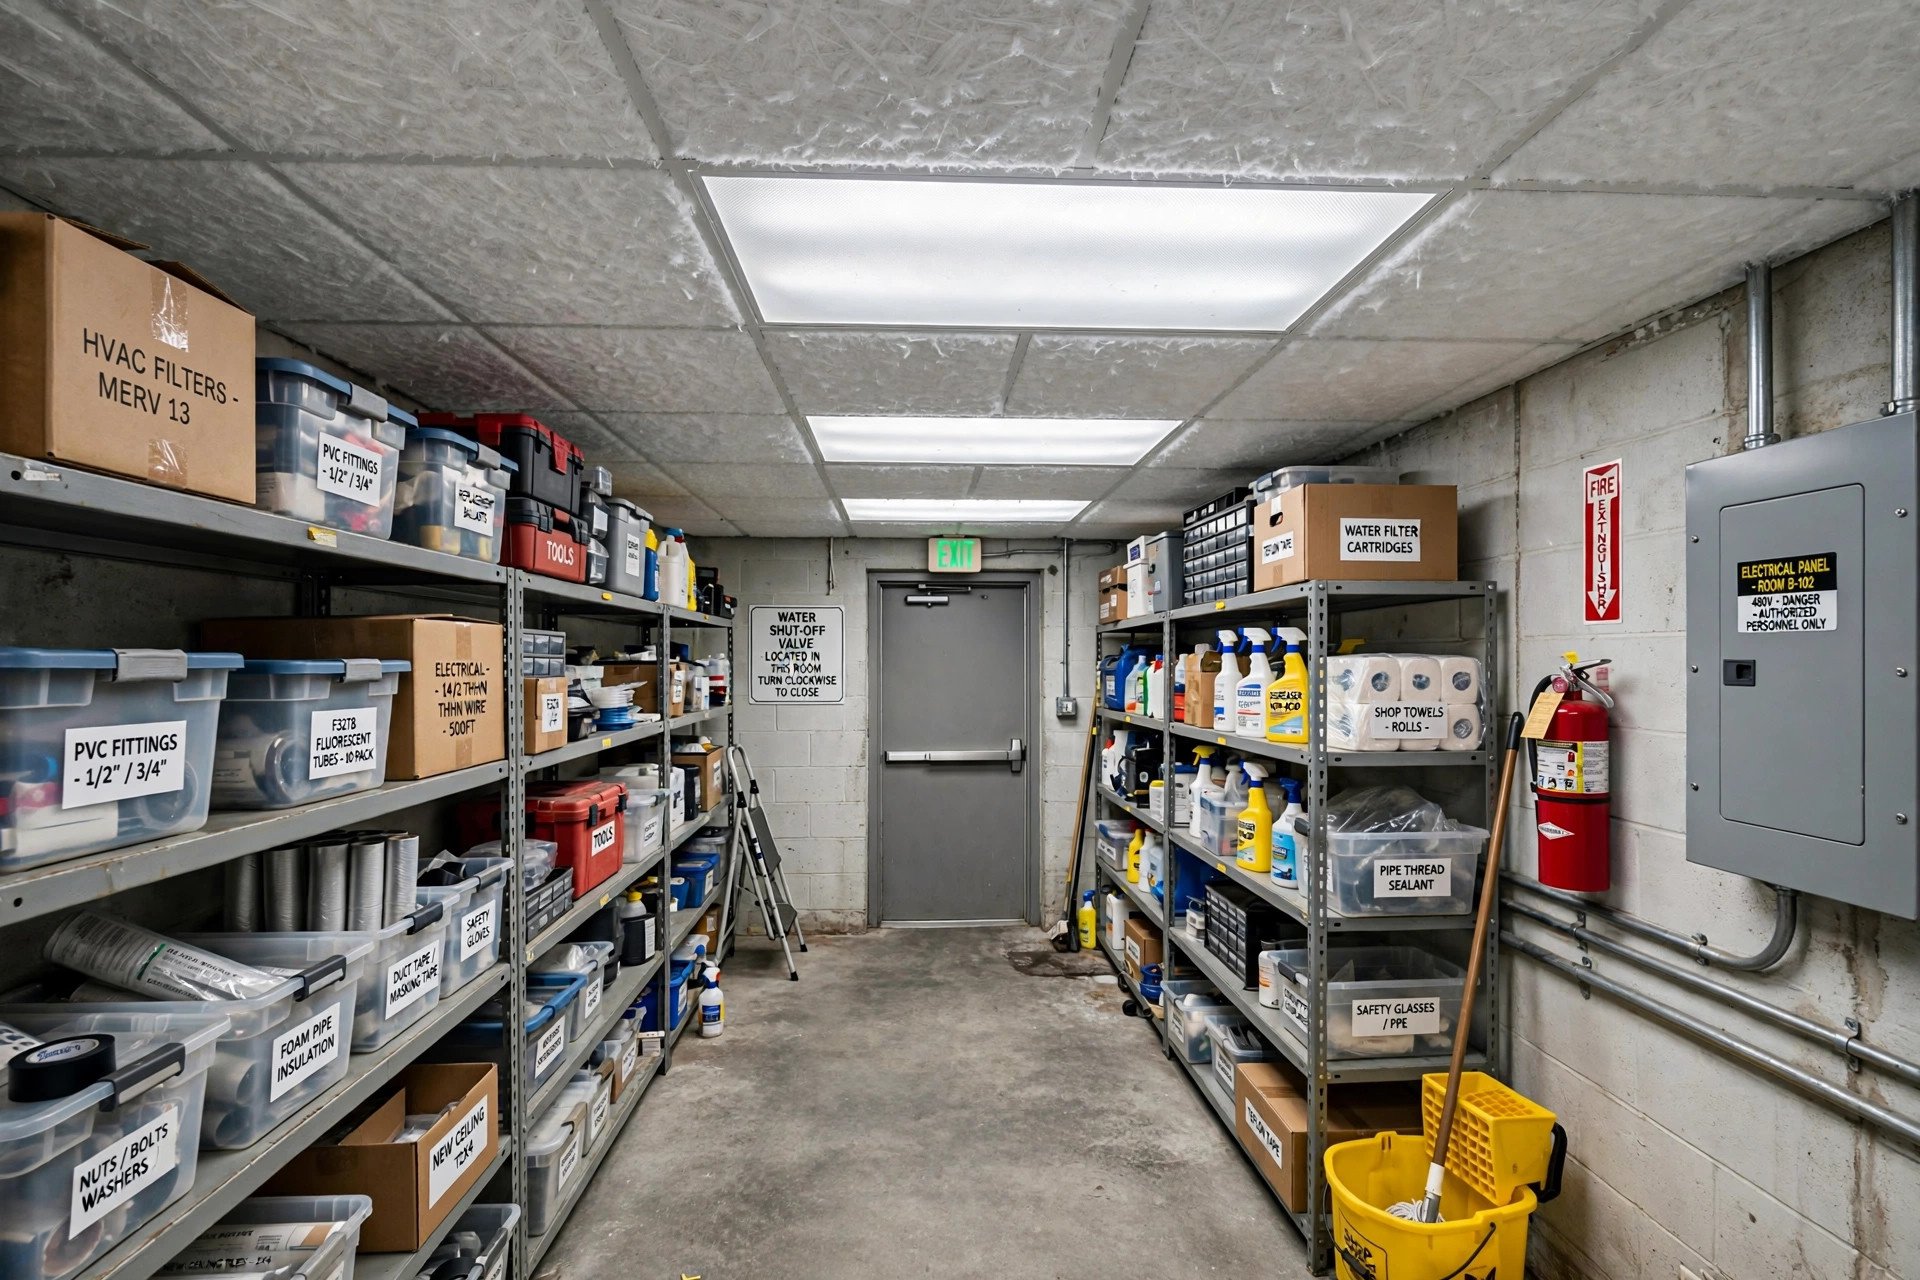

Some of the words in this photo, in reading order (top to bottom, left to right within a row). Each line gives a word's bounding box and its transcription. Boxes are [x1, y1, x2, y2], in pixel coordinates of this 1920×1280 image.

[83, 327, 146, 375] HVAC
[154, 356, 227, 404] FILTERS
[99, 371, 161, 415] MERV
[168, 398, 190, 425] 13
[323, 443, 341, 463] PVC
[342, 451, 378, 475] FITTINGS
[329, 466, 348, 484] 1/2"
[355, 474, 373, 491] 3/4"
[1590, 476, 1615, 498] FIRE
[1345, 525, 1381, 537] WATER
[1384, 525, 1419, 538] FILTER
[546, 540, 574, 566] TOOLS
[937, 540, 975, 568] EXIT
[1347, 541, 1413, 554] CARTRIDGES
[1741, 561, 1795, 579] ELECTRICAL
[1798, 557, 1830, 573] PANEL
[1757, 578, 1785, 592] ROOM
[1787, 575, 1815, 590] B-102
[1782, 593, 1821, 606] DANGER
[777, 611, 816, 623] WATER
[1746, 619, 1799, 632] PERSONNEL
[1801, 618, 1827, 630] ONLY
[769, 624, 826, 636] SHUT-OFF
[778, 637, 814, 649] VALVE
[765, 651, 808, 662] LOCATED
[811, 651, 820, 661] IN
[435, 662, 485, 677] ELECTRICAL
[770, 663, 791, 673] THIS
[793, 663, 821, 674] ROOM
[442, 682, 462, 698] 14/2
[757, 675, 783, 685] TURN
[785, 675, 837, 686] CLOCKWISE
[775, 687, 788, 697] TO
[790, 687, 819, 697] CLOSE
[438, 700, 463, 718] THHN
[464, 699, 487, 716] WIRE
[1374, 706, 1402, 718] SHOP
[1403, 706, 1444, 718] TOWELS
[332, 716, 357, 731] F32T8
[449, 719, 476, 737] 500FT
[1391, 721, 1422, 733] ROLLS
[74, 740, 108, 762] PVC
[112, 733, 178, 757] FITTINGS
[316, 731, 371, 751] FLUORESCENT
[313, 752, 339, 769] TUBES
[345, 751, 354, 764] 10
[355, 748, 374, 763] PACK
[86, 764, 121, 789] 1/2"
[123, 762, 133, 785] /
[136, 758, 167, 782] 3/4"
[593, 826, 613, 848] TOOLS
[1380, 865, 1402, 876] PIPE
[1403, 864, 1445, 876] THREAD
[1388, 879, 1435, 891] SEALANT
[466, 909, 490, 932] SAFETY
[466, 926, 490, 948] GLOVES
[393, 963, 412, 984] DUCT
[413, 951, 431, 971] TAPE
[421, 964, 438, 983] TAPE
[1356, 1003, 1392, 1016] SAFETY
[1394, 1002, 1435, 1014] GLASSES
[1390, 1017, 1408, 1029] PPE
[280, 1028, 310, 1060] FOAM
[312, 1015, 332, 1040] PIPE
[277, 1033, 335, 1083] INSULATION
[432, 1136, 454, 1172] NEW
[455, 1106, 485, 1147] CEILING
[79, 1155, 117, 1193] NUTS
[130, 1122, 169, 1160] BOLTS
[81, 1157, 149, 1213] WASHERS
